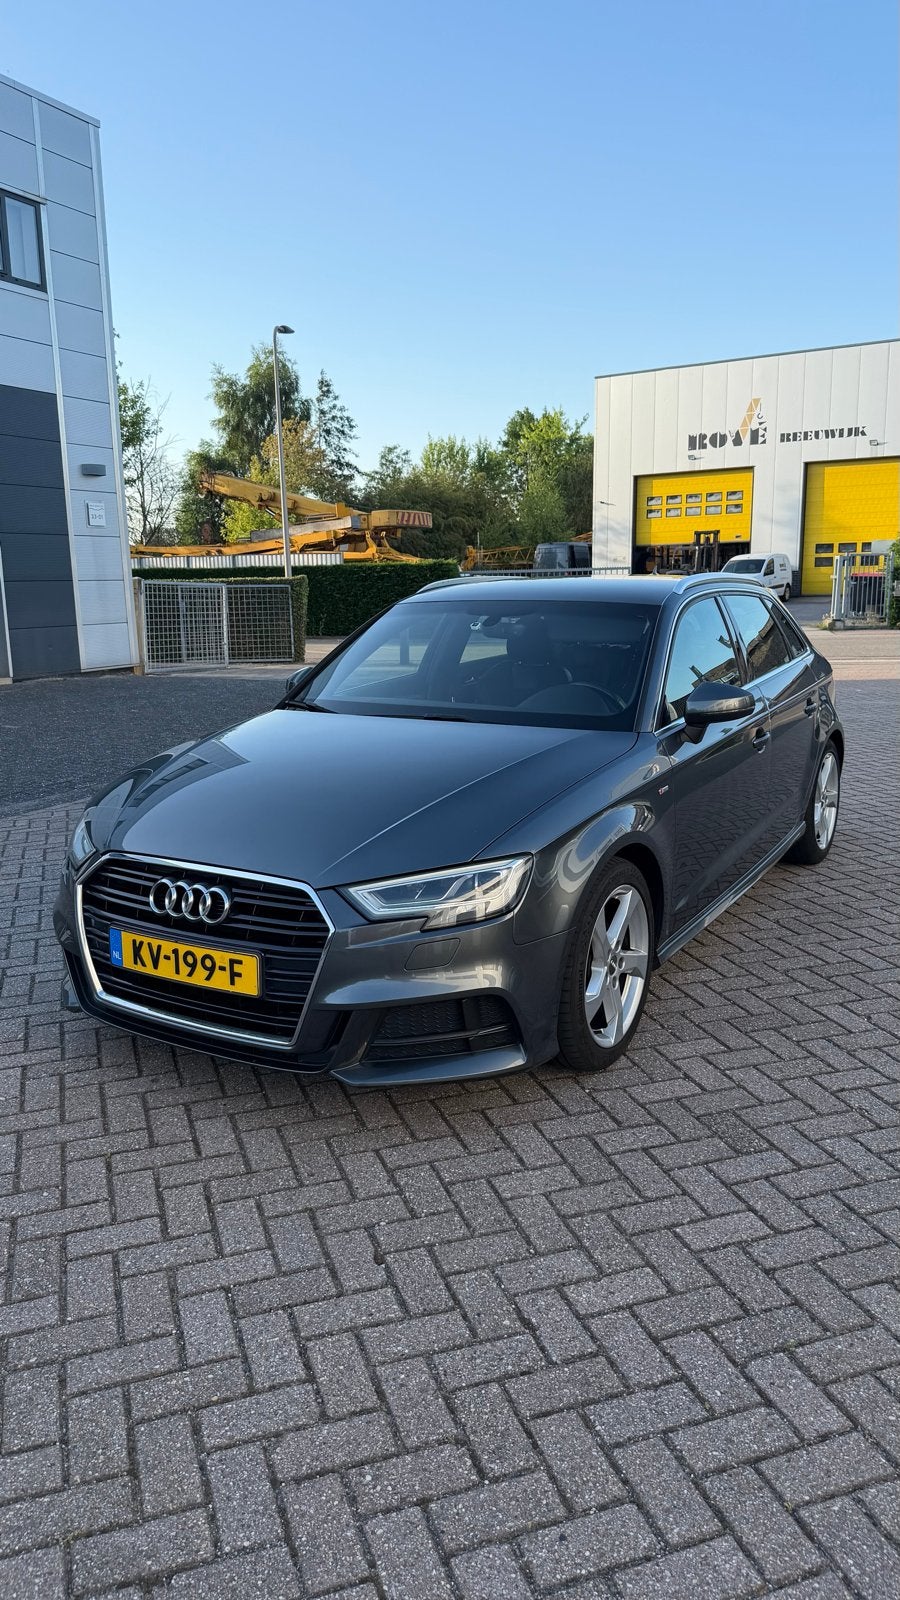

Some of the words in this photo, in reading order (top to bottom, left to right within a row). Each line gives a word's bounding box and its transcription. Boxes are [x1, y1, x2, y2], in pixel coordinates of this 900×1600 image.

[780, 426, 867, 443] REEUWIJK
[112, 950, 122, 960] NL
[131, 938, 244, 986] KV-199-F
